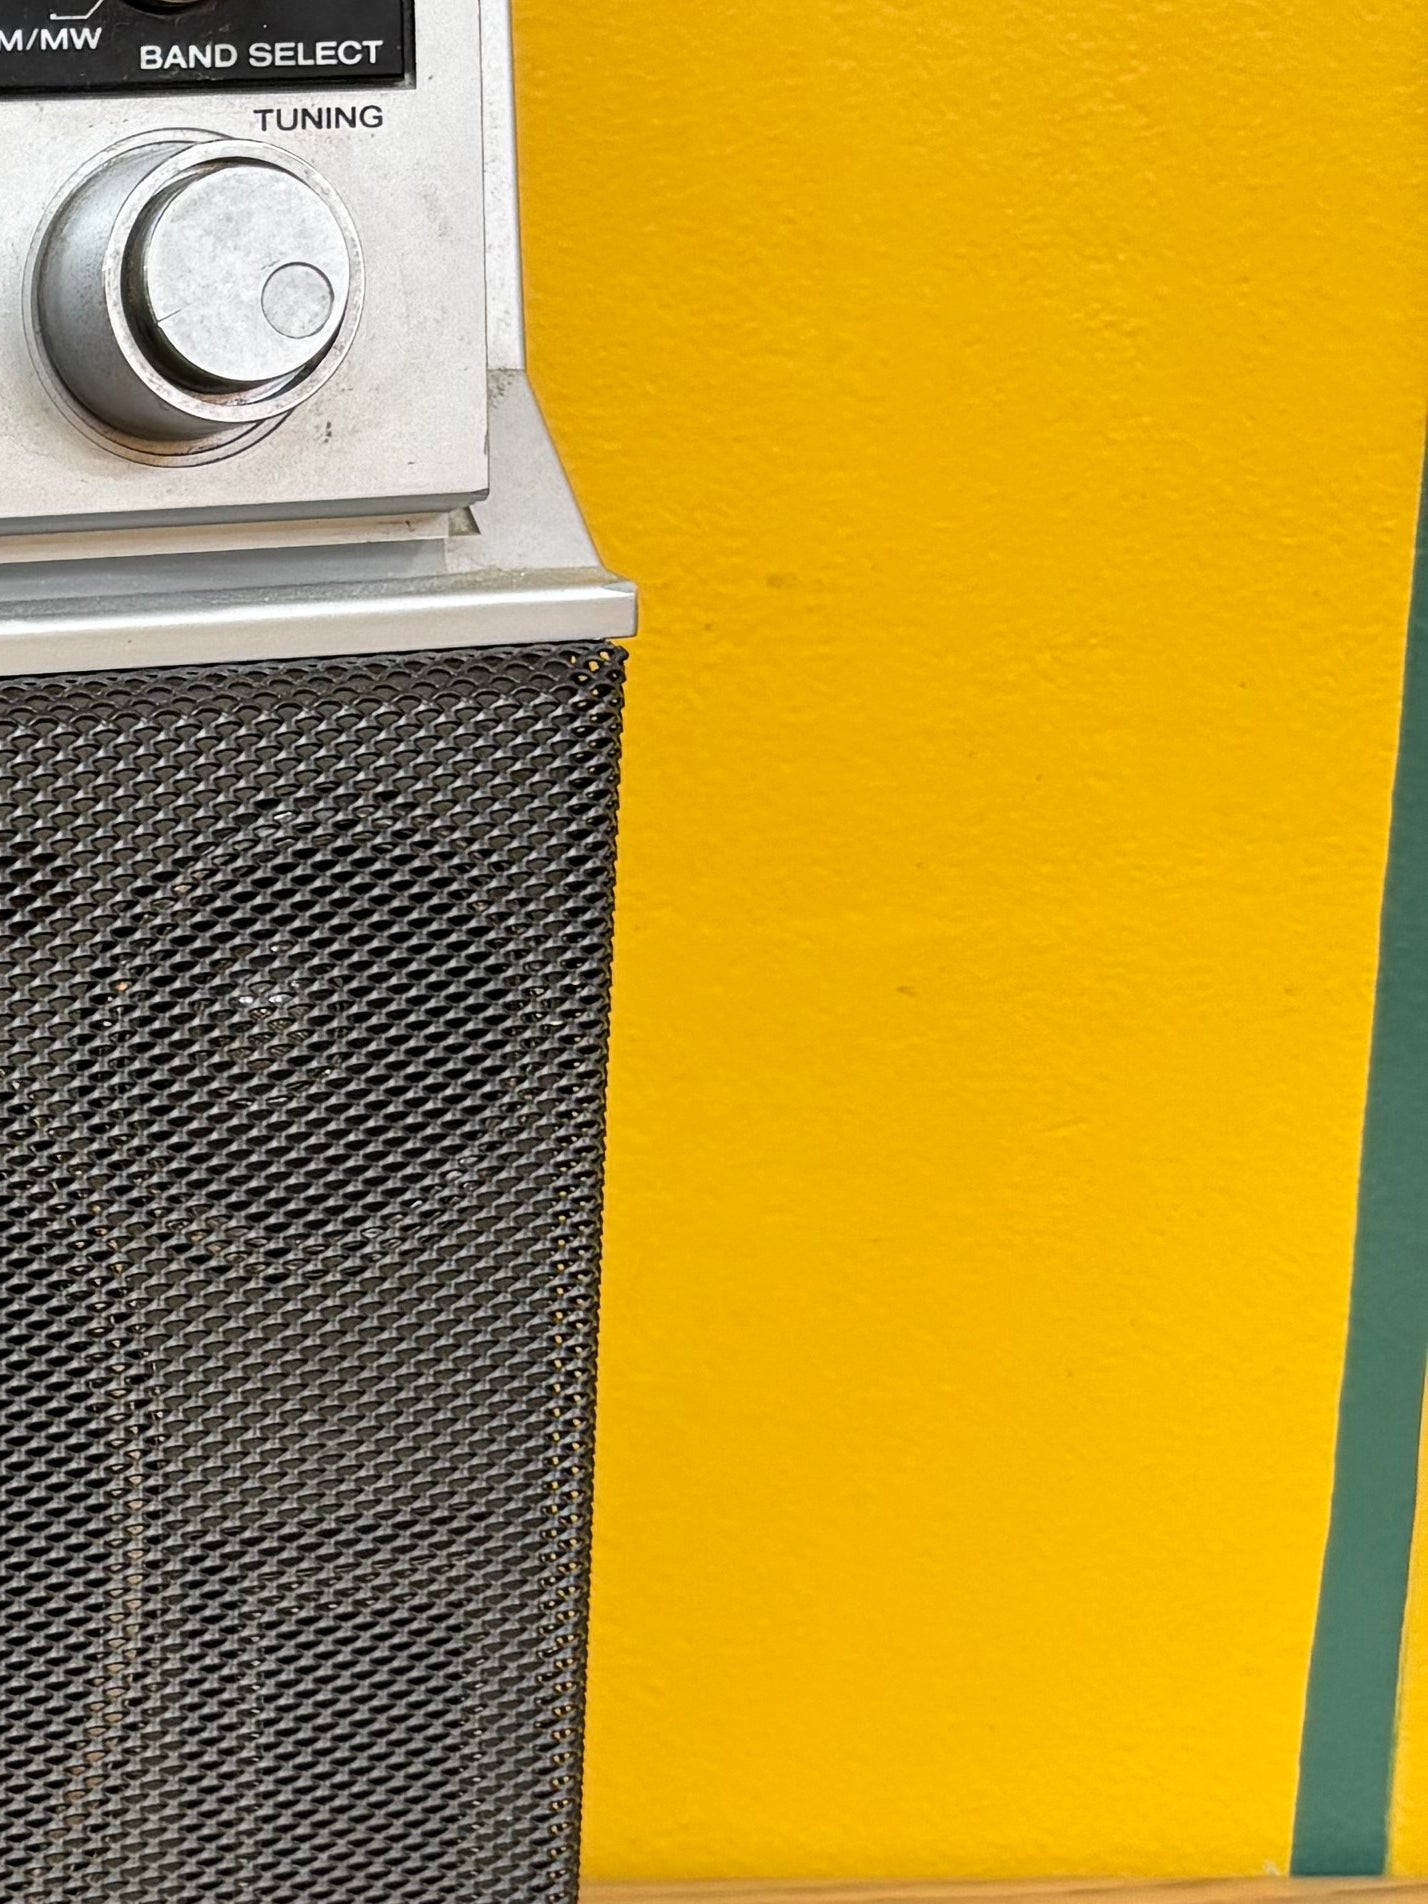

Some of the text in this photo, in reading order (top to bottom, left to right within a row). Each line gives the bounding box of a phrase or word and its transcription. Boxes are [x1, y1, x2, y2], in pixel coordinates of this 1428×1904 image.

[139, 39, 384, 71] BAND SELECT
[253, 105, 384, 132] TUNING
